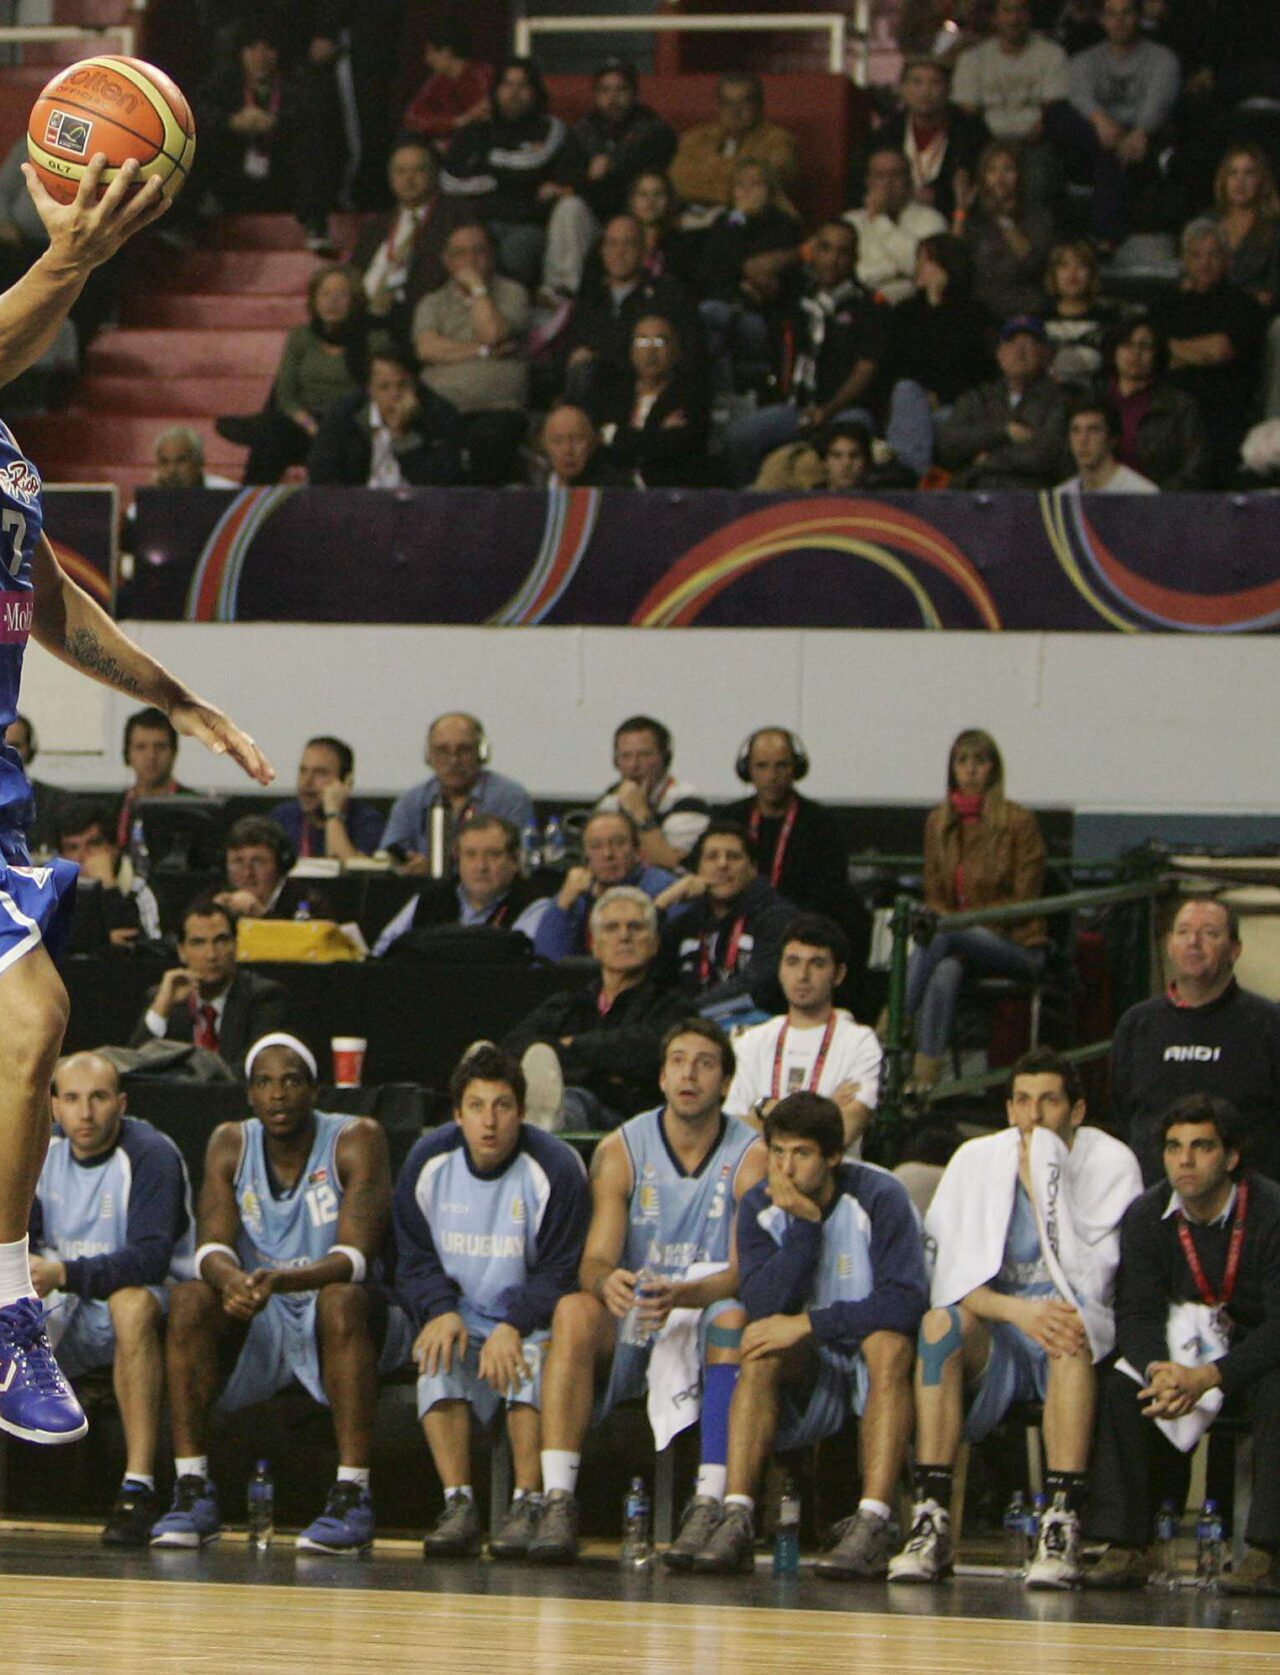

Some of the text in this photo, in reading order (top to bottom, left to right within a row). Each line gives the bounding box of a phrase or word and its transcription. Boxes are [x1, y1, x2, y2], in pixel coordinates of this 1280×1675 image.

[48, 160, 71, 174] GL7
[1, 507, 26, 576] 7
[305, 1183, 339, 1228] 12
[440, 1228, 525, 1259] URUGUAY
